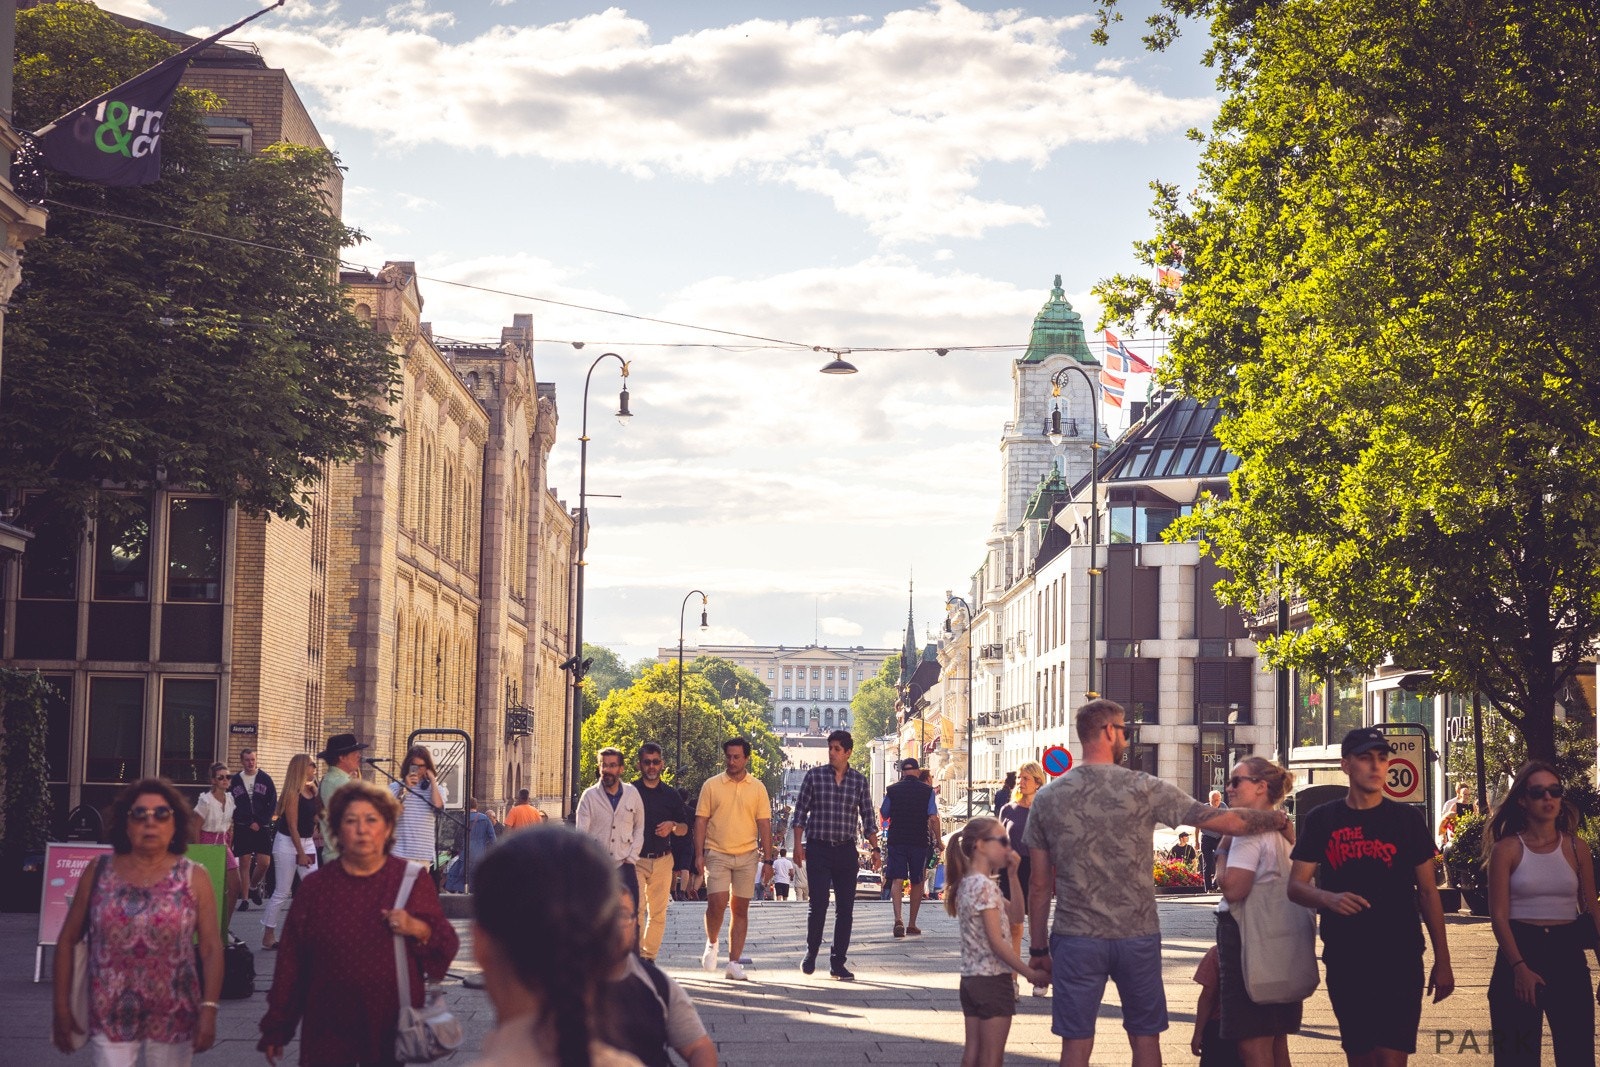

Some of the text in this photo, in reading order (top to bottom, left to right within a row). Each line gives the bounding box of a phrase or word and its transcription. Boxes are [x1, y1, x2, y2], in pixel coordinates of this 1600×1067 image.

[426, 745, 455, 757] one
[1204, 753, 1222, 763] DNB
[1387, 768, 1413, 788] 30
[1333, 826, 1364, 841] THE
[69, 868, 82, 878] SH
